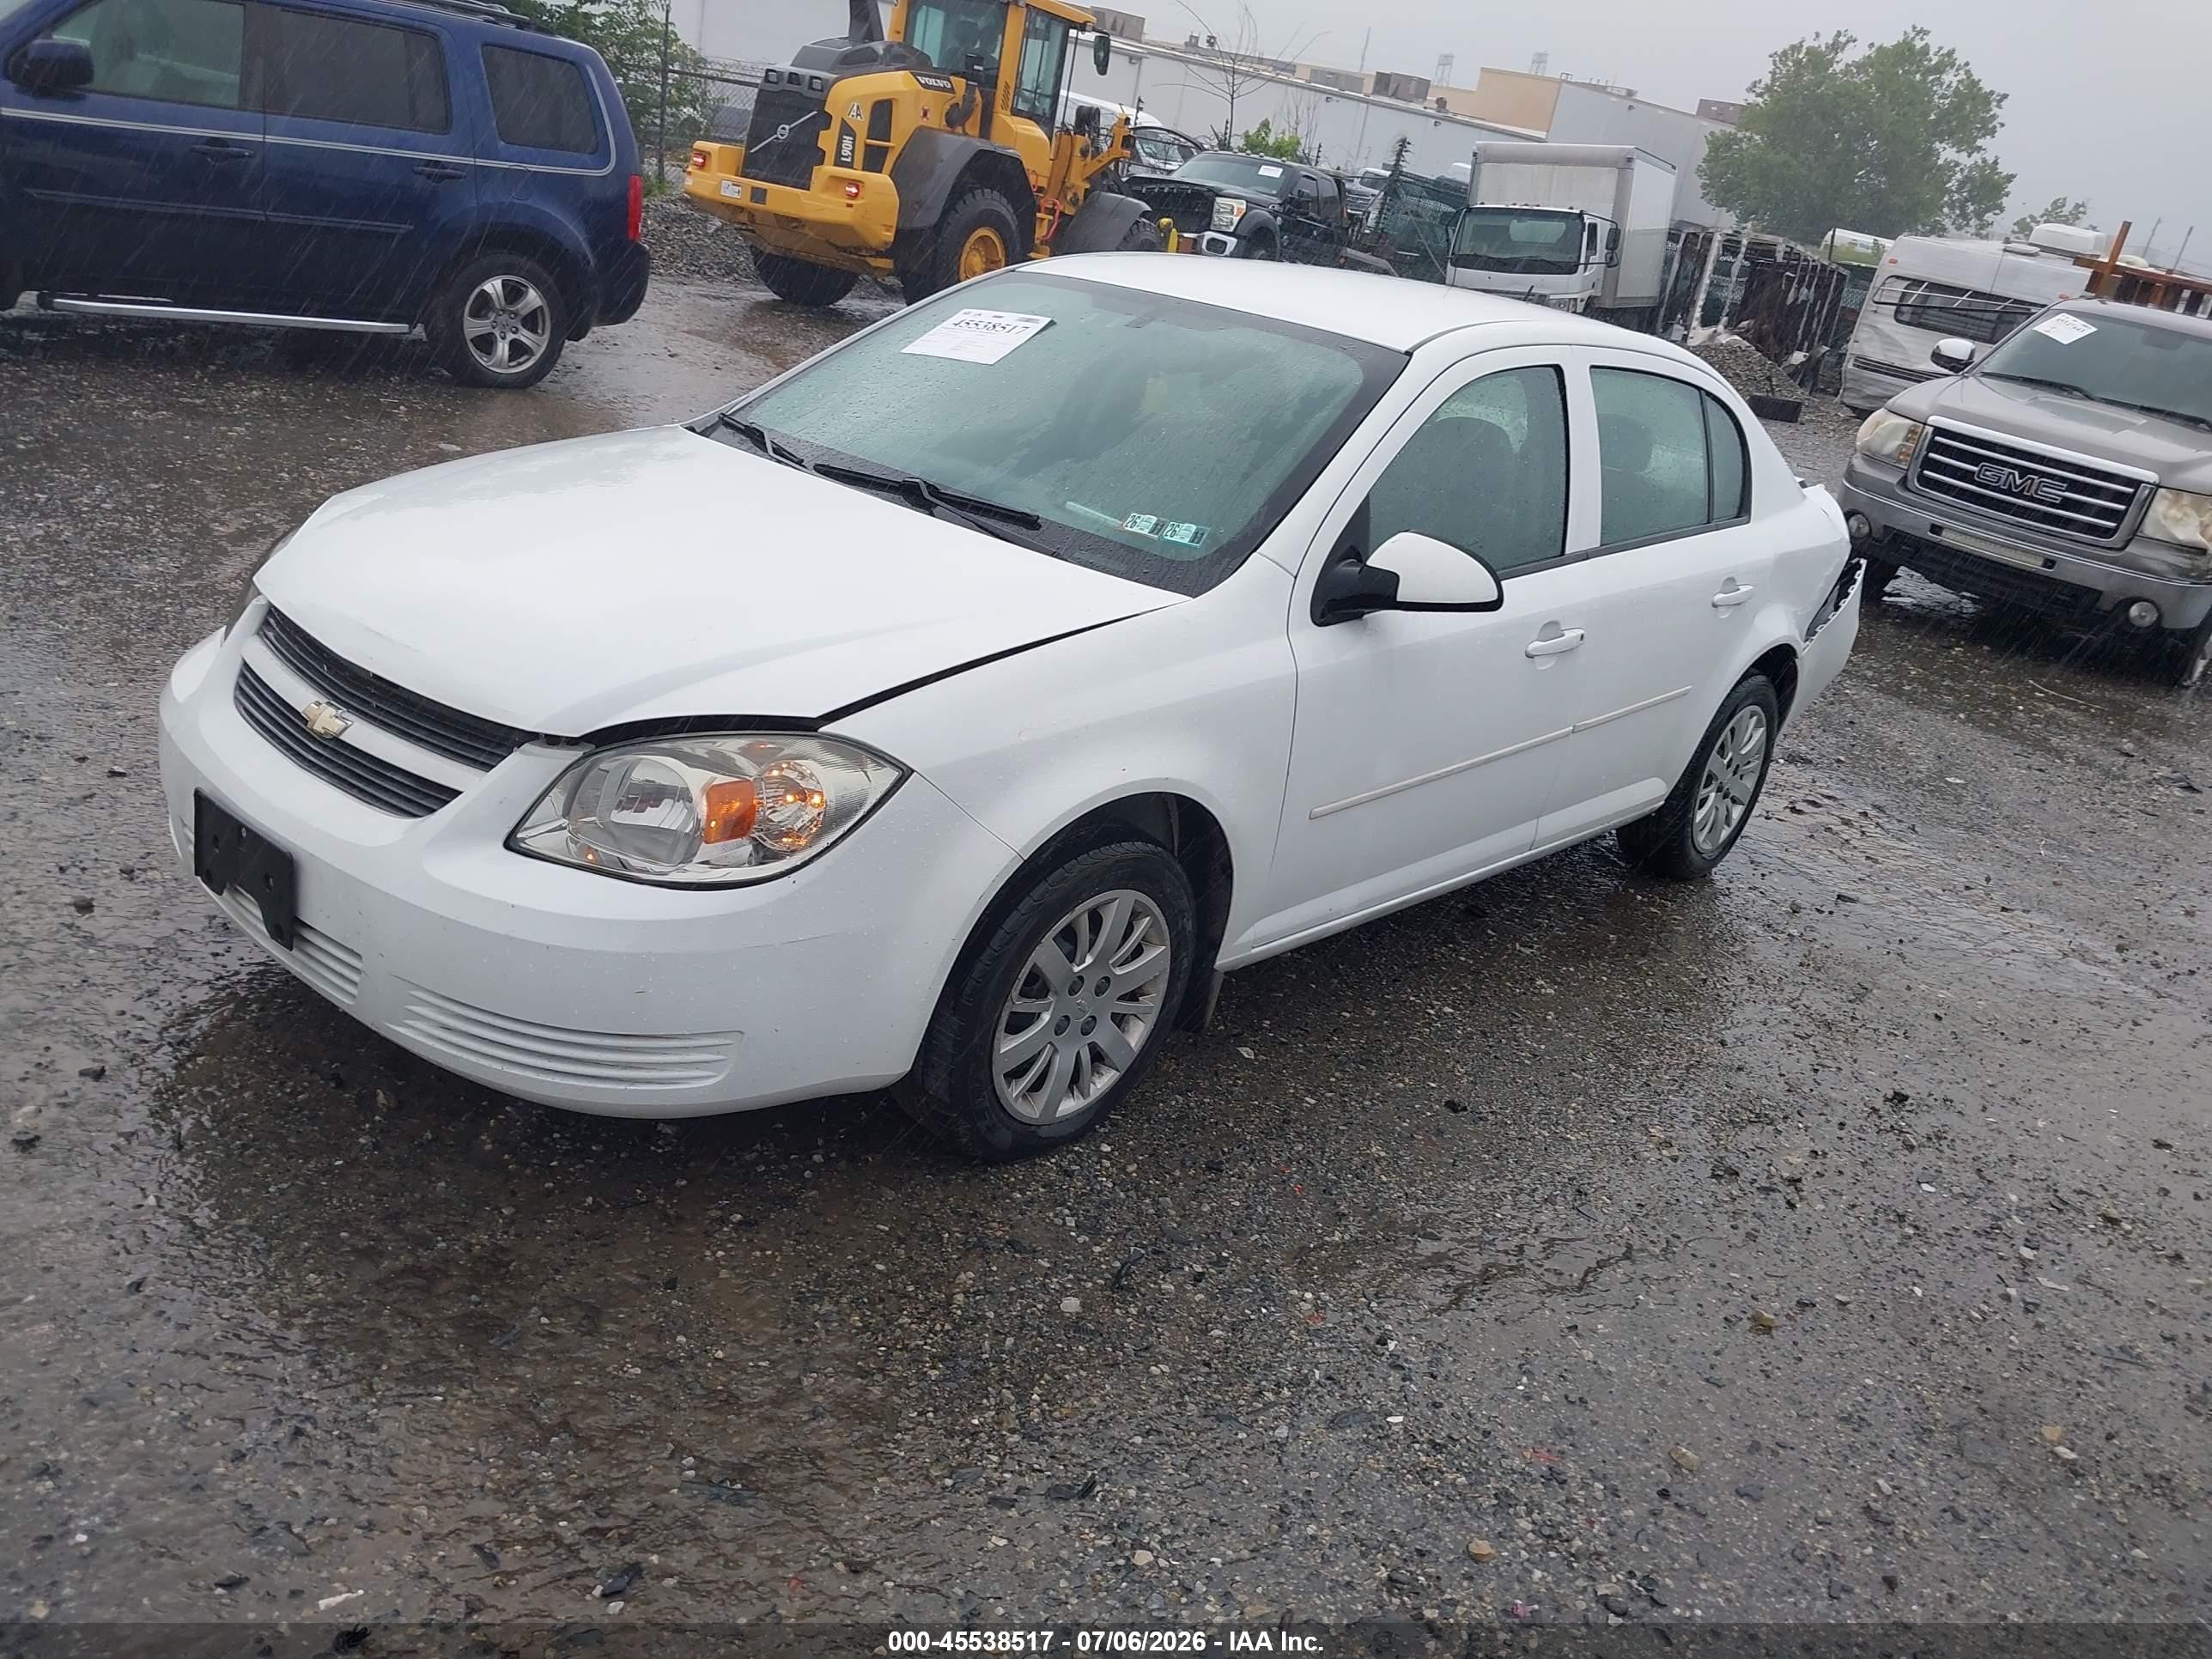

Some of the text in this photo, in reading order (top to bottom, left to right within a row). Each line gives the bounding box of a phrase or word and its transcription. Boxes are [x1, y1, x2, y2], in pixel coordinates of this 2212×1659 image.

[915, 76, 951, 88] VOLVO
[841, 135, 854, 162] L90H
[952, 319, 1030, 334] 45538517
[1974, 462, 2068, 503] GMC
[1125, 515, 1140, 529] 26
[1164, 523, 1180, 538] 26
